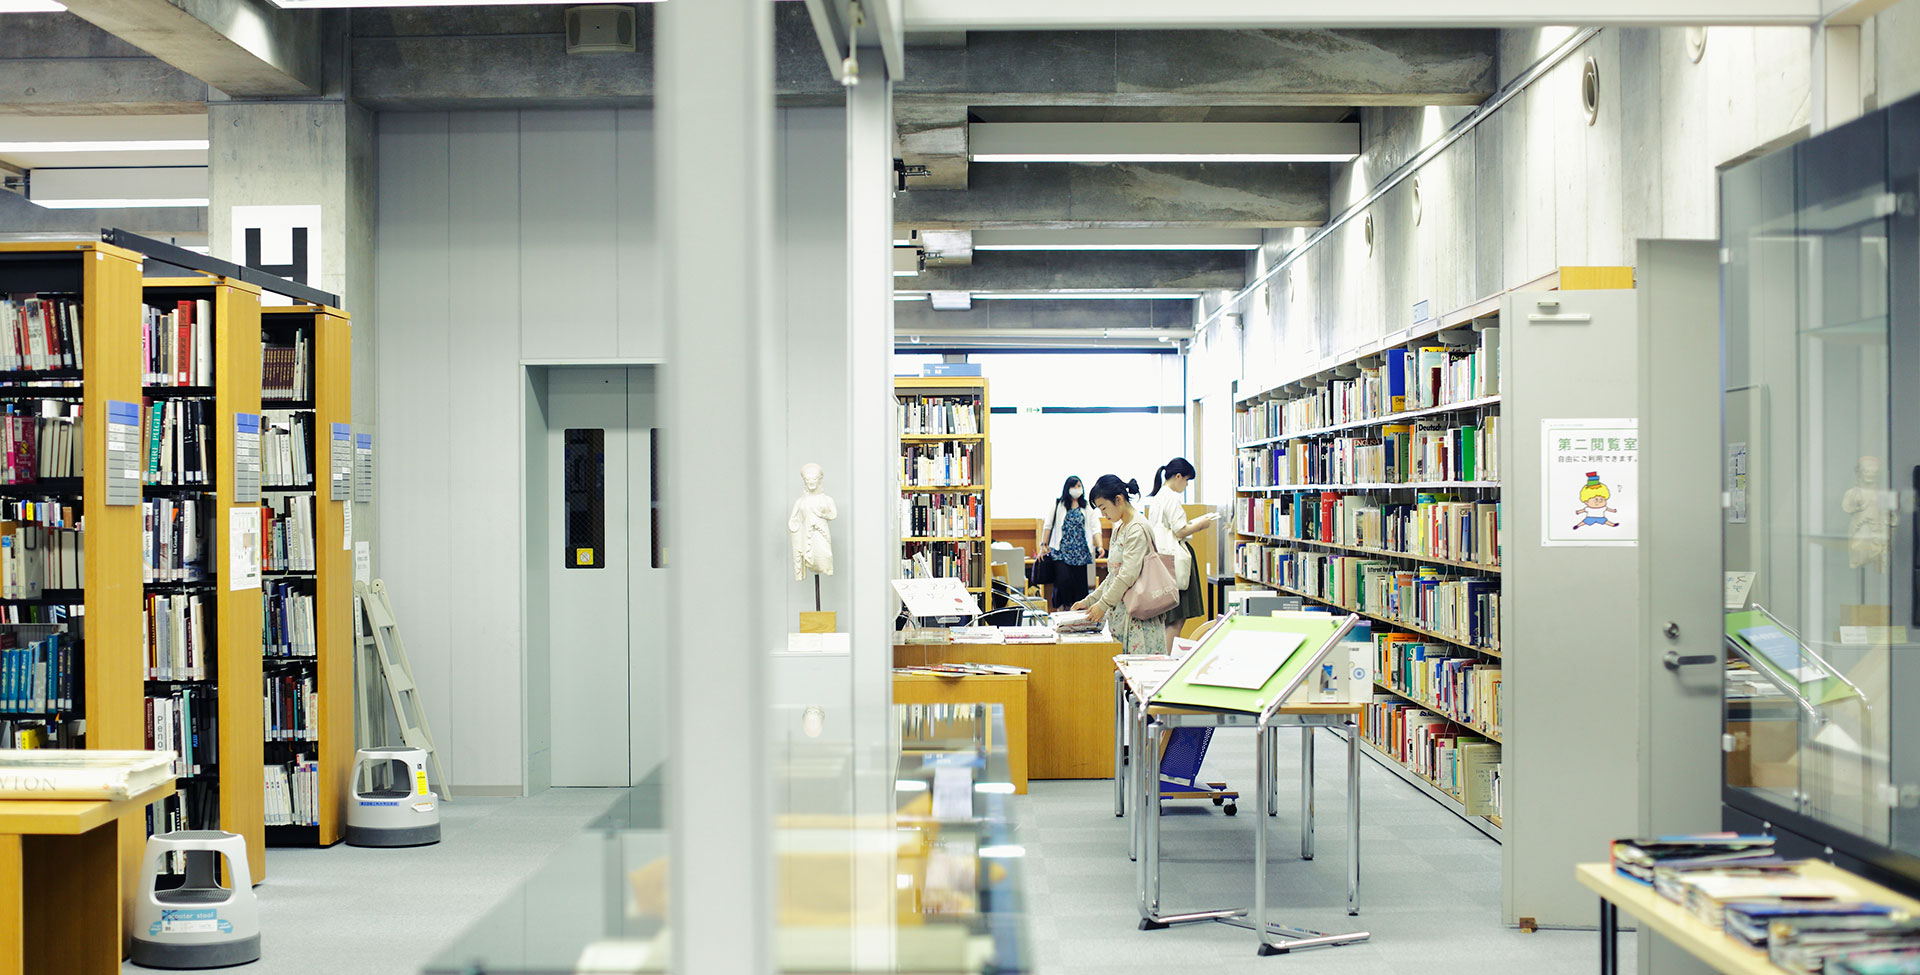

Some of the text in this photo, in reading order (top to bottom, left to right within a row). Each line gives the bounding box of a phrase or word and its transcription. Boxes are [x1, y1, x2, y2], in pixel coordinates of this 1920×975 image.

[245, 227, 307, 306] H
[1558, 438, 1637, 451] 第二閲覧室
[1558, 455, 1637, 463] 自由にご利用できます。
